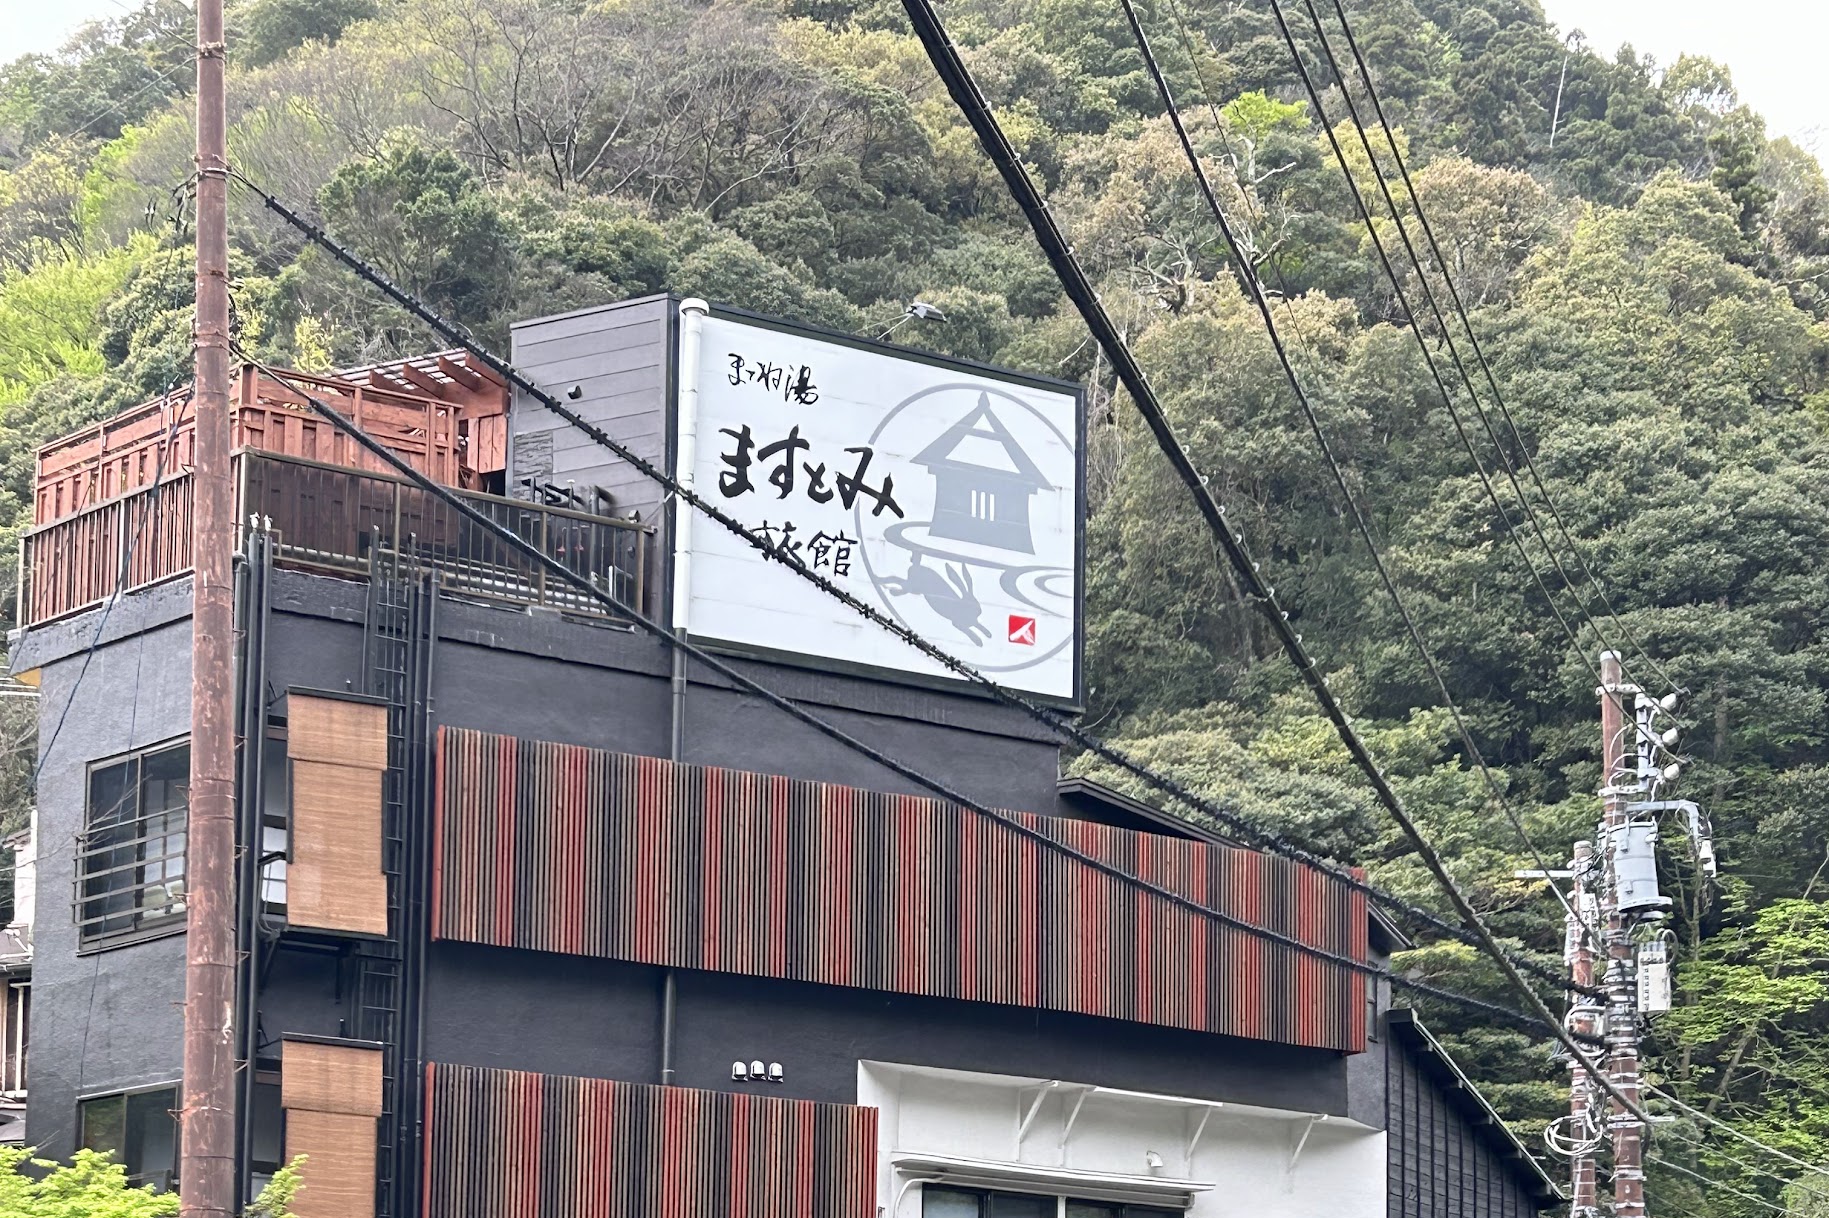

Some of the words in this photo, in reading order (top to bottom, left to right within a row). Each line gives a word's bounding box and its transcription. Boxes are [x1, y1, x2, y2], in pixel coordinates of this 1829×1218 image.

[719, 424, 904, 518] ますとみ
[748, 520, 859, 577] 旅館
